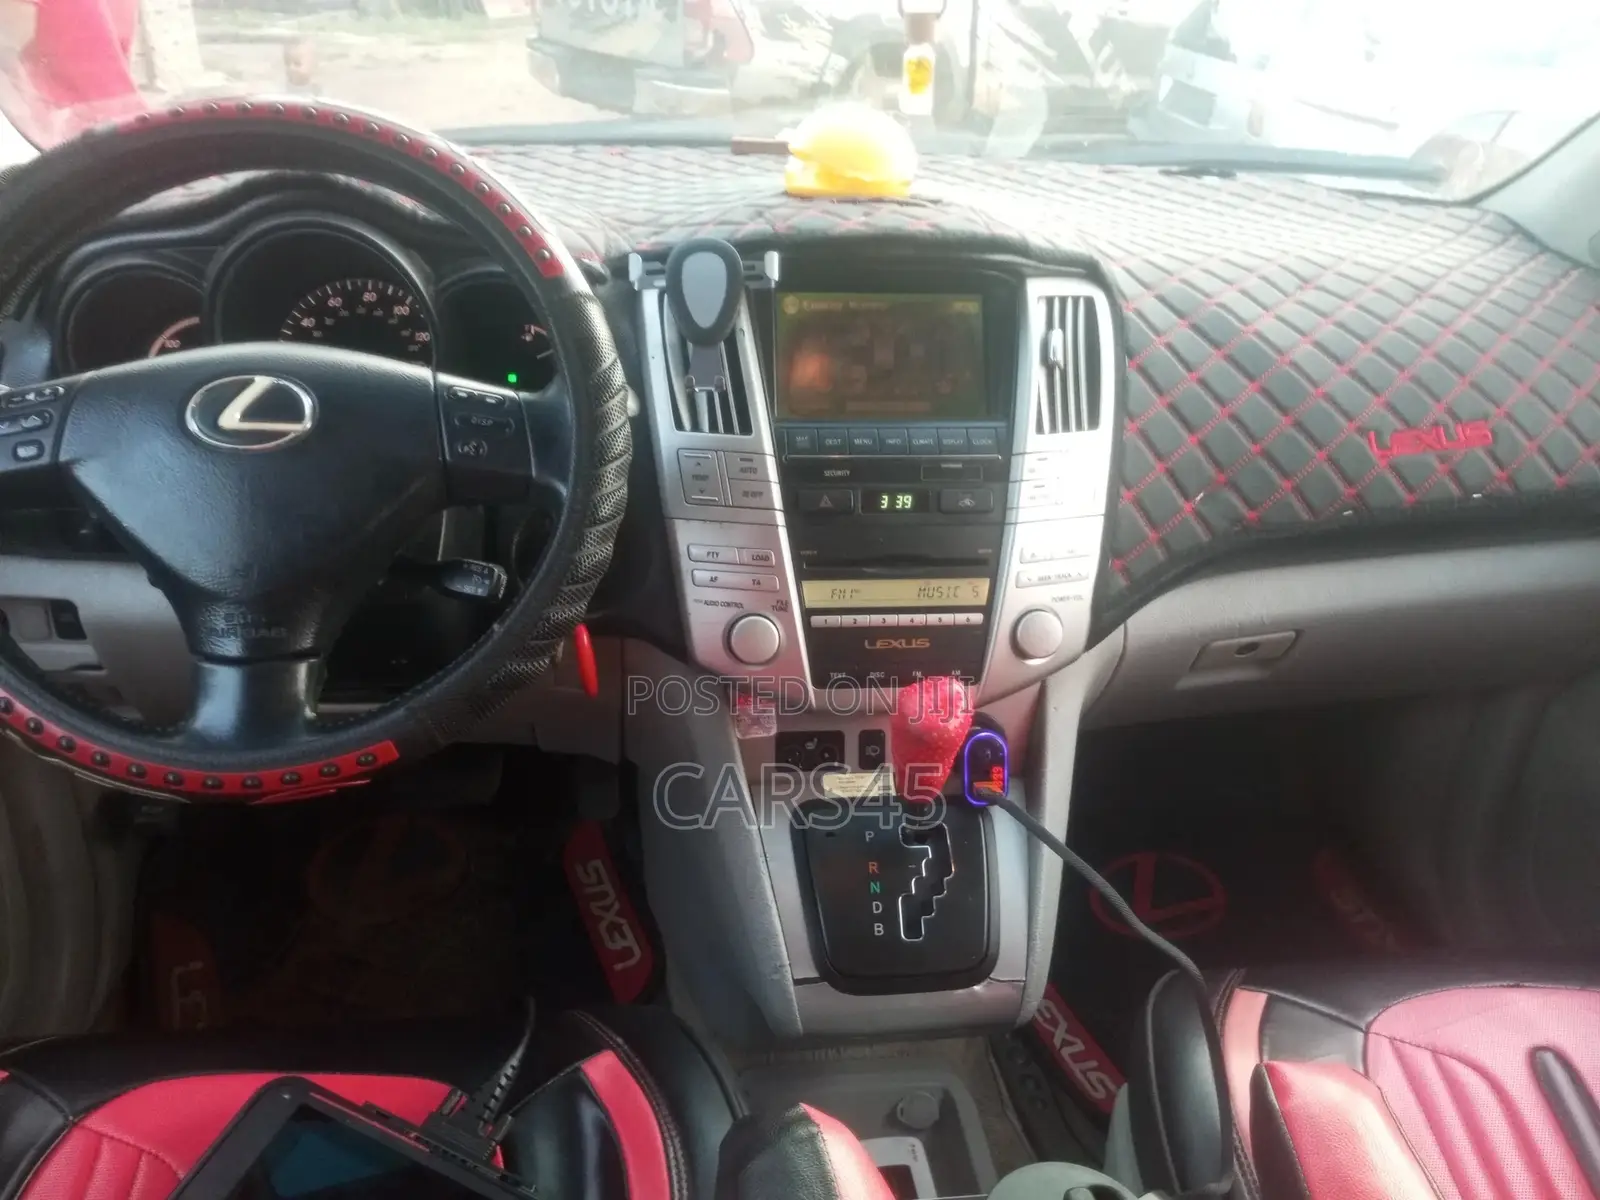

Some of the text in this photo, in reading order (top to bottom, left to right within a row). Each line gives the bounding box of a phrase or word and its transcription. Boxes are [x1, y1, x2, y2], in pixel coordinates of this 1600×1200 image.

[854, 438, 873, 446] MENU
[1367, 420, 1493, 458] LEXUS
[823, 469, 850, 477] SECURITY
[917, 585, 961, 598] MUSIC
[864, 638, 931, 649] LEXUS
[865, 832, 875, 842] P
[868, 862, 880, 874] R
[870, 882, 881, 894] N
[872, 901, 883, 914] D
[574, 858, 642, 971] LEXUS
[874, 923, 885, 936] B
[1033, 998, 1118, 1099] EXUS
